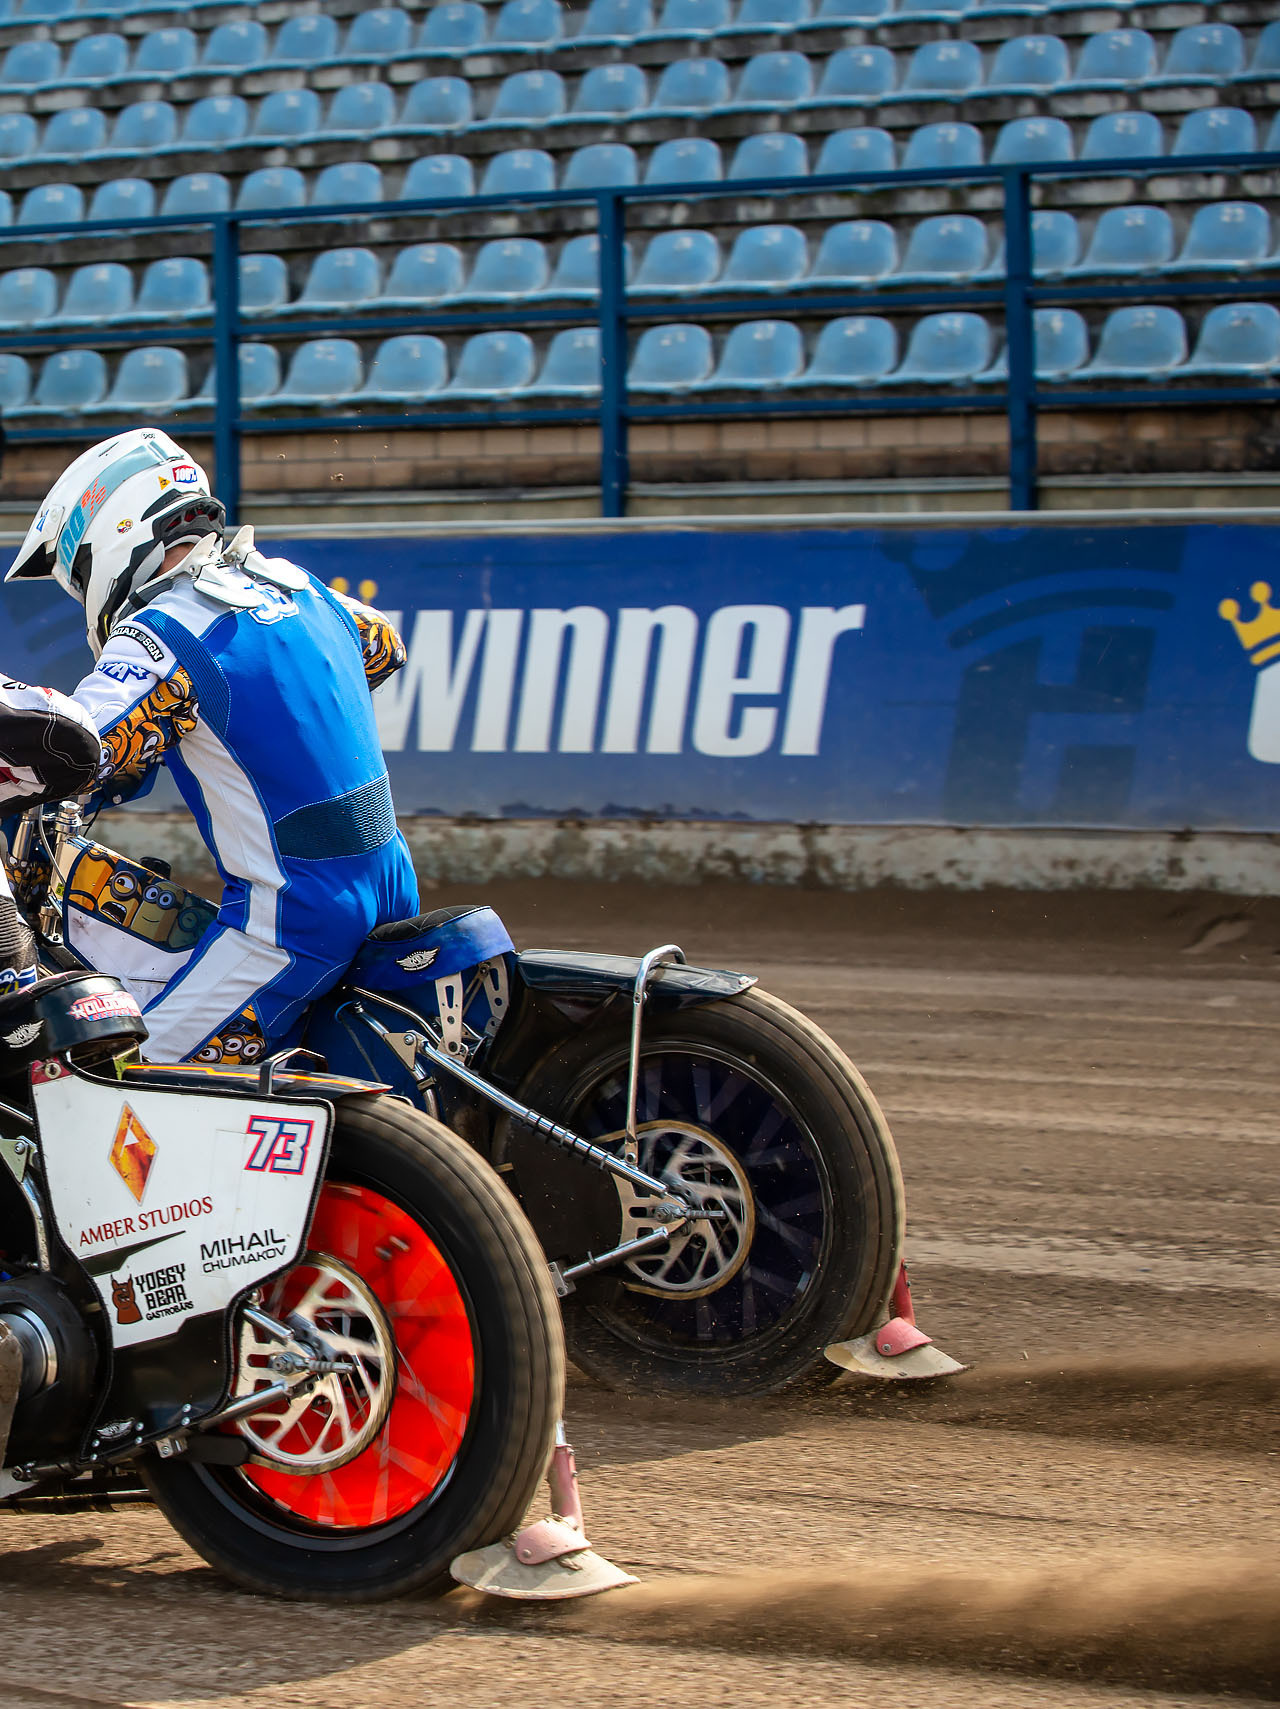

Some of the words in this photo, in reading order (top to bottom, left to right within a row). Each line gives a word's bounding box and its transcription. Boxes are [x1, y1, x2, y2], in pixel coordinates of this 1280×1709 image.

[374, 603, 866, 757] winner
[244, 1115, 315, 1175] 73
[79, 1217, 136, 1247] AMBER
[138, 1196, 214, 1231] STUDIOS
[200, 1228, 286, 1260] MIHAIL
[202, 1245, 287, 1274] CHUMAKOV
[135, 1263, 187, 1293] YOGGY
[144, 1283, 187, 1311] BEAR
